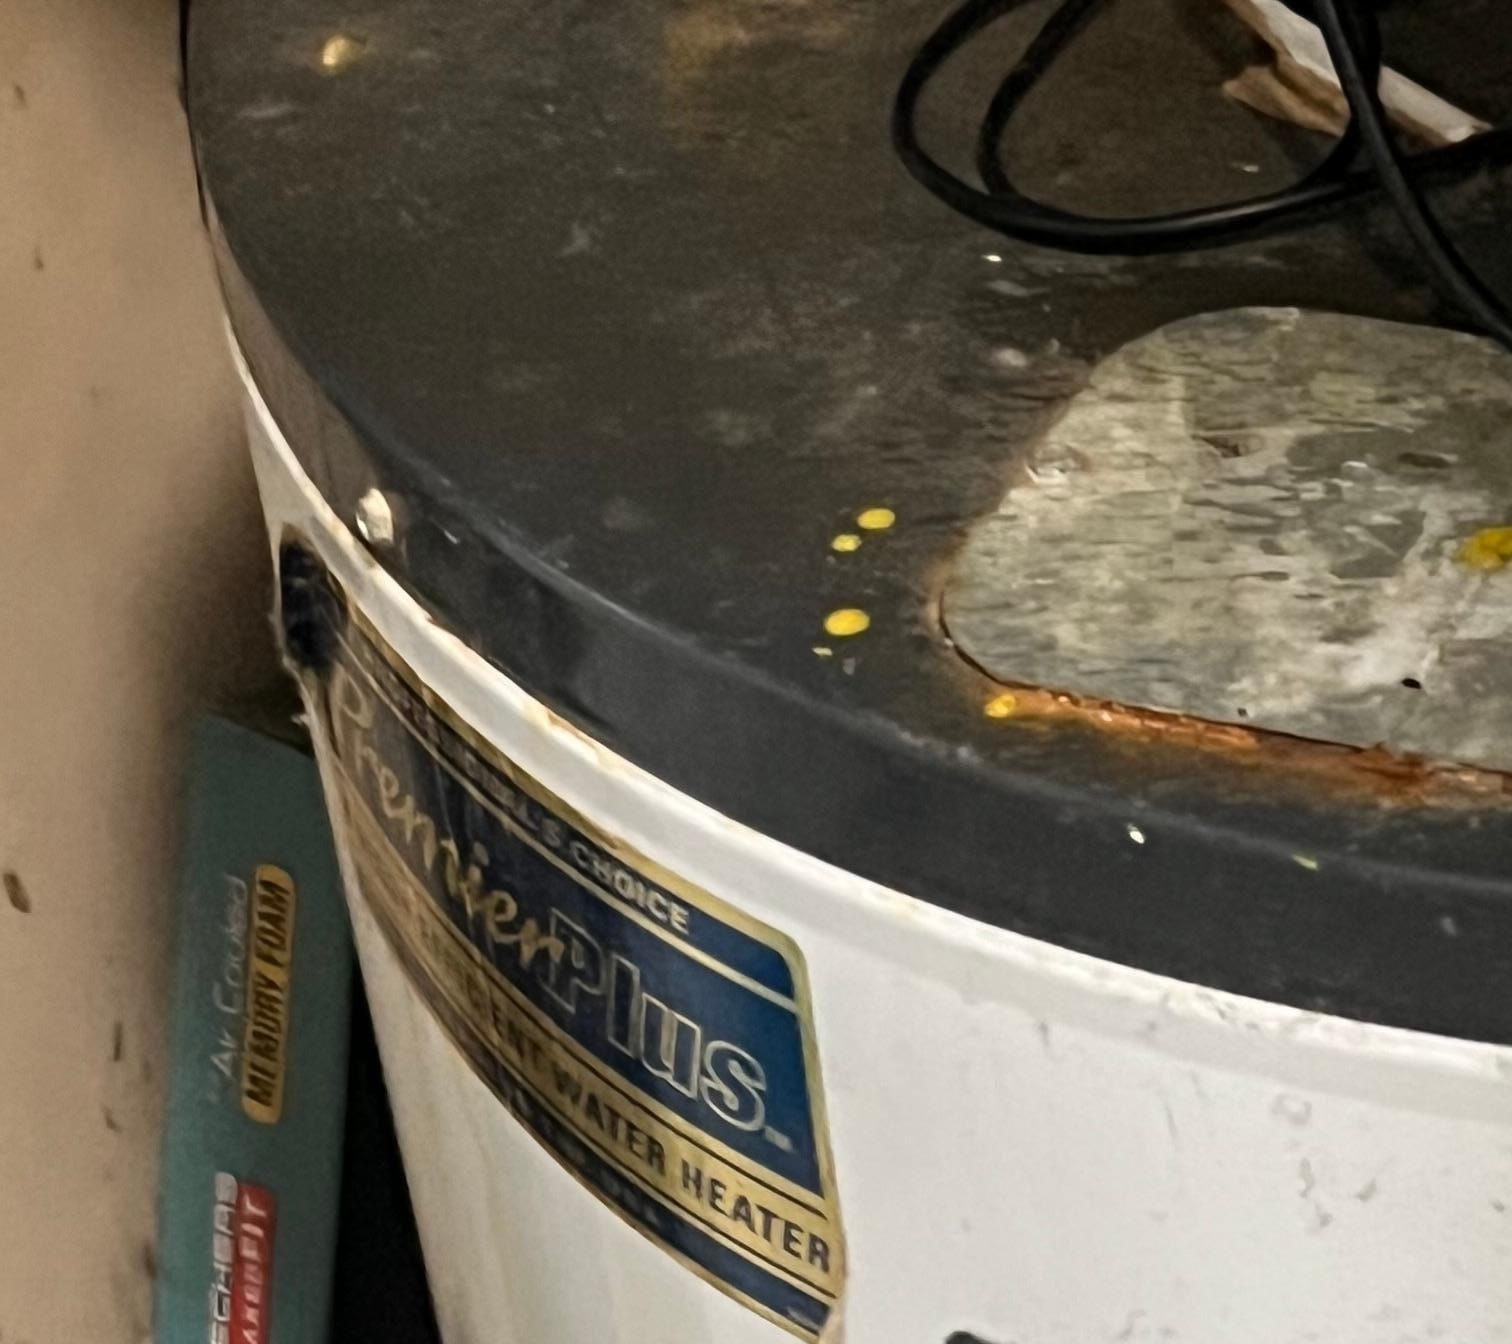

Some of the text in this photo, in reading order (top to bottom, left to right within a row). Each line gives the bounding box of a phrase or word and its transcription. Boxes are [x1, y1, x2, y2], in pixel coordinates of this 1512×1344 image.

[245, 879, 291, 1108] MEMORY FOAM
[569, 836, 692, 935] CHOICE
[548, 905, 771, 1136] Plus
[553, 1066, 667, 1177] WATER
[681, 1159, 831, 1274] HEATER
